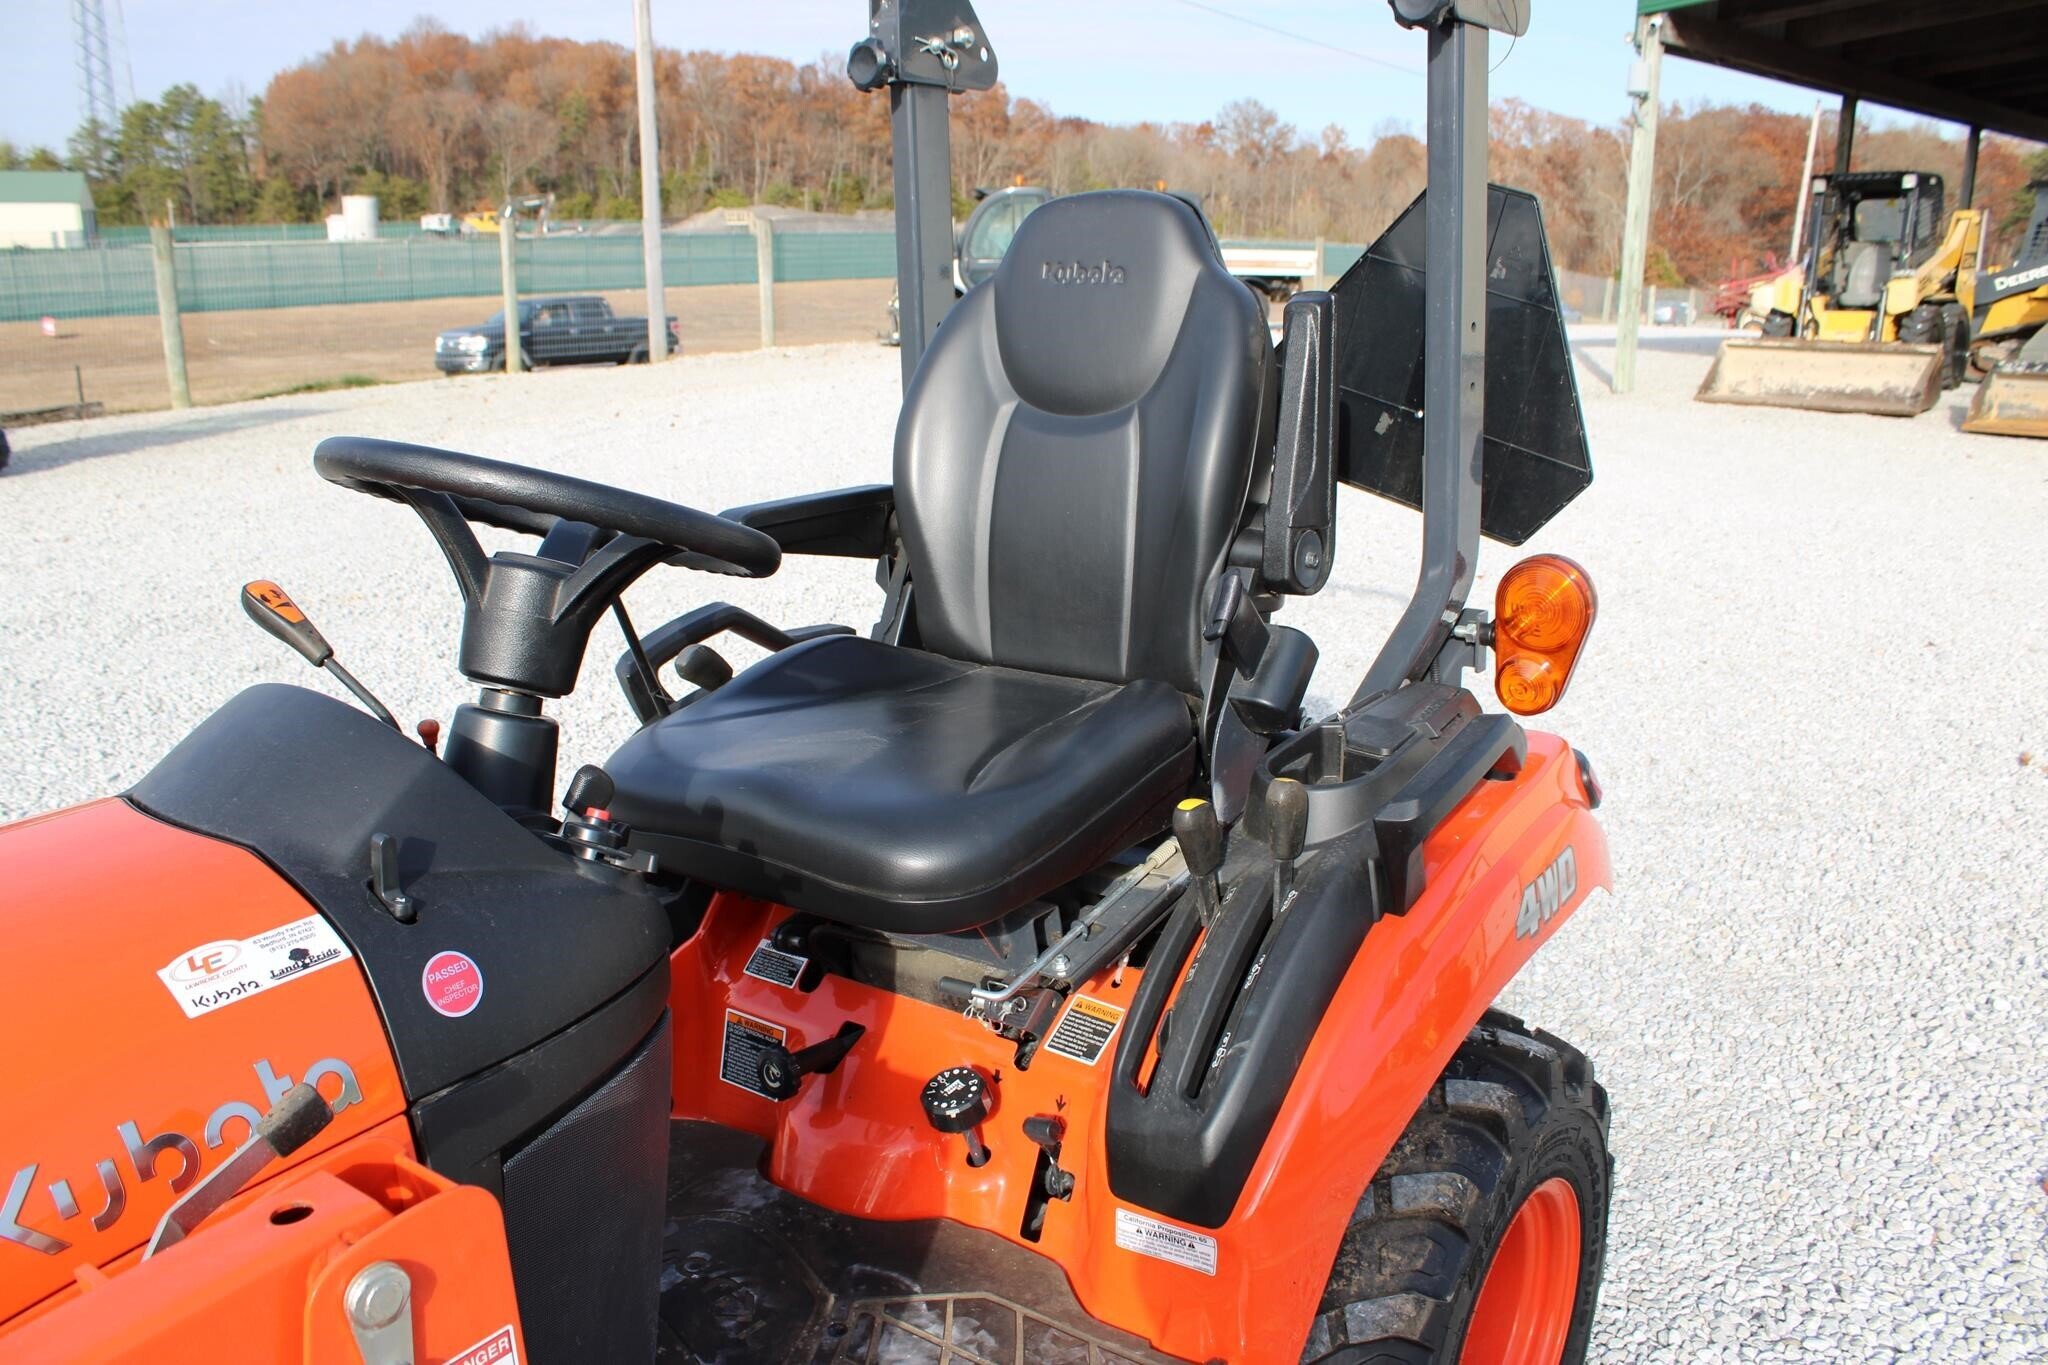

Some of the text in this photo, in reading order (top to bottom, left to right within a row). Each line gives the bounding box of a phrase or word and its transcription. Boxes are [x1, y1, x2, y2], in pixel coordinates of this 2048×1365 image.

[1041, 259, 1126, 285] Kubota
[1994, 264, 2048, 291] DEERE
[1516, 844, 1577, 941] 4WD
[270, 947, 339, 979] Land Pride
[427, 960, 469, 985] PASSED
[191, 979, 261, 1008] Kubota
[436, 983, 478, 1006] INSPECTOR
[444, 979, 465, 994] CHIEF
[1085, 1003, 1120, 1020] WARNING
[1123, 1214, 1156, 1230] California
[1157, 1224, 1198, 1241] Proposition
[1144, 1228, 1187, 1247] WARNING
[463, 1337, 510, 1365] NGER
